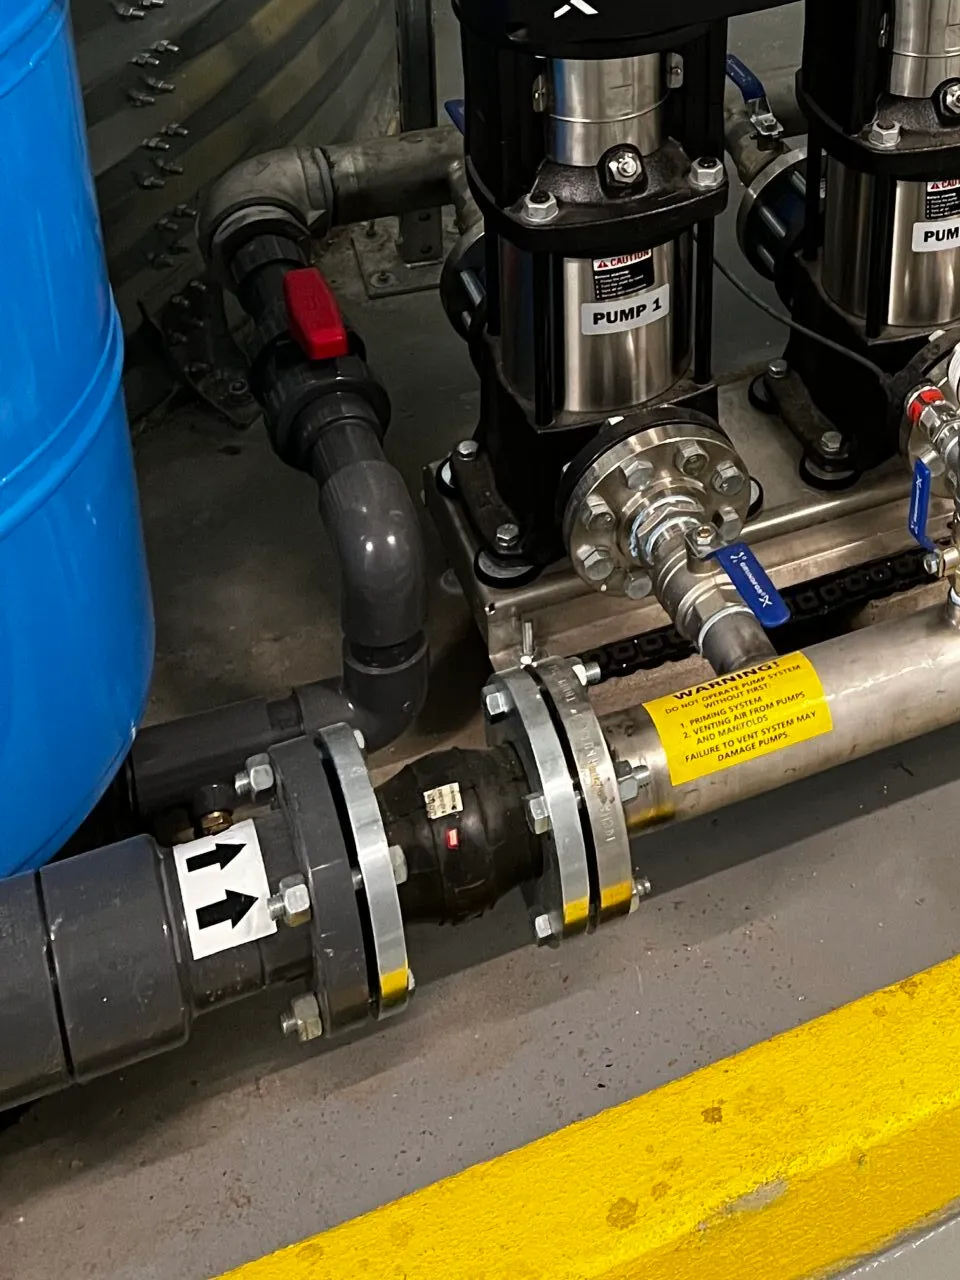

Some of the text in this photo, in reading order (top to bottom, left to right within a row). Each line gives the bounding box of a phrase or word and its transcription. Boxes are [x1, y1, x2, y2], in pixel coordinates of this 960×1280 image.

[593, 297, 661, 325] PUMP 1
[665, 665, 801, 714] DO NOT OPERATE PUMP SYSTEM
[673, 661, 779, 700] WARNING!
[689, 709, 727, 725] PRIMING
[728, 696, 763, 712] SYSTEM
[693, 718, 731, 736] VENTING
[733, 711, 748, 722] AIR
[749, 702, 774, 716] FROM
[776, 691, 806, 707] PUMPS
[704, 692, 745, 709] WITHOUT
[685, 711, 817, 763] FAILURE TO VENT SYSTEM MAY
[696, 714, 769, 745] AND MANIFOLDS
[718, 744, 756, 762] DAMAGE
